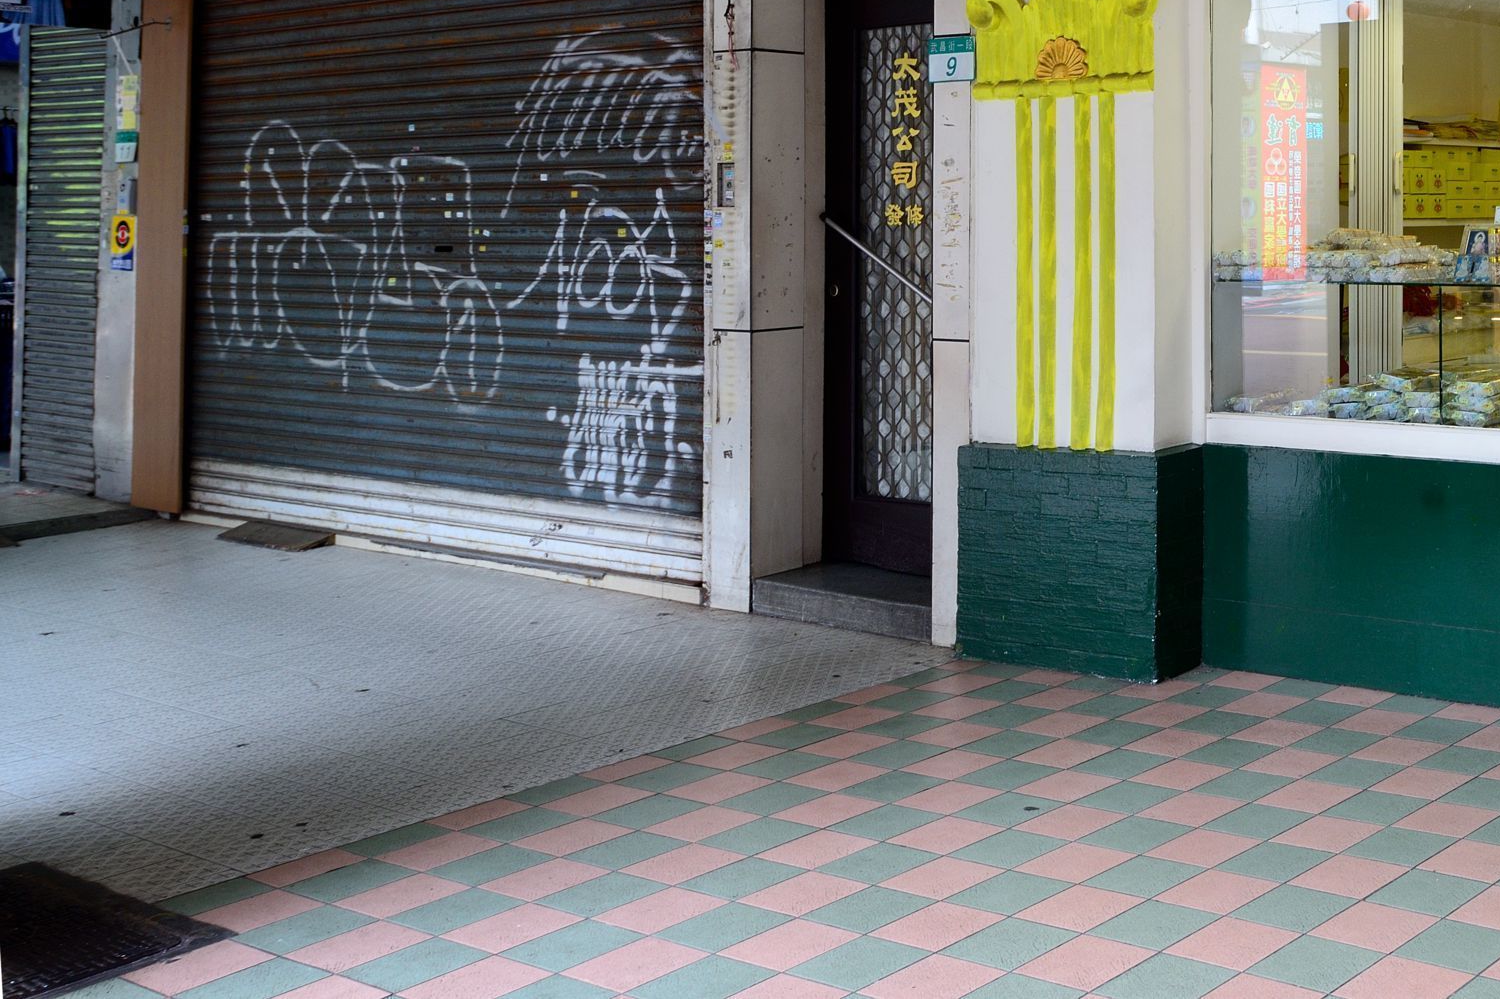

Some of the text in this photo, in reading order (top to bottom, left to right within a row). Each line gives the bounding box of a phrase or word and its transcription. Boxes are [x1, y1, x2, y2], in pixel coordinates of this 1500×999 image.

[946, 56, 957, 77] 9
[891, 52, 921, 189] 太茂公司
